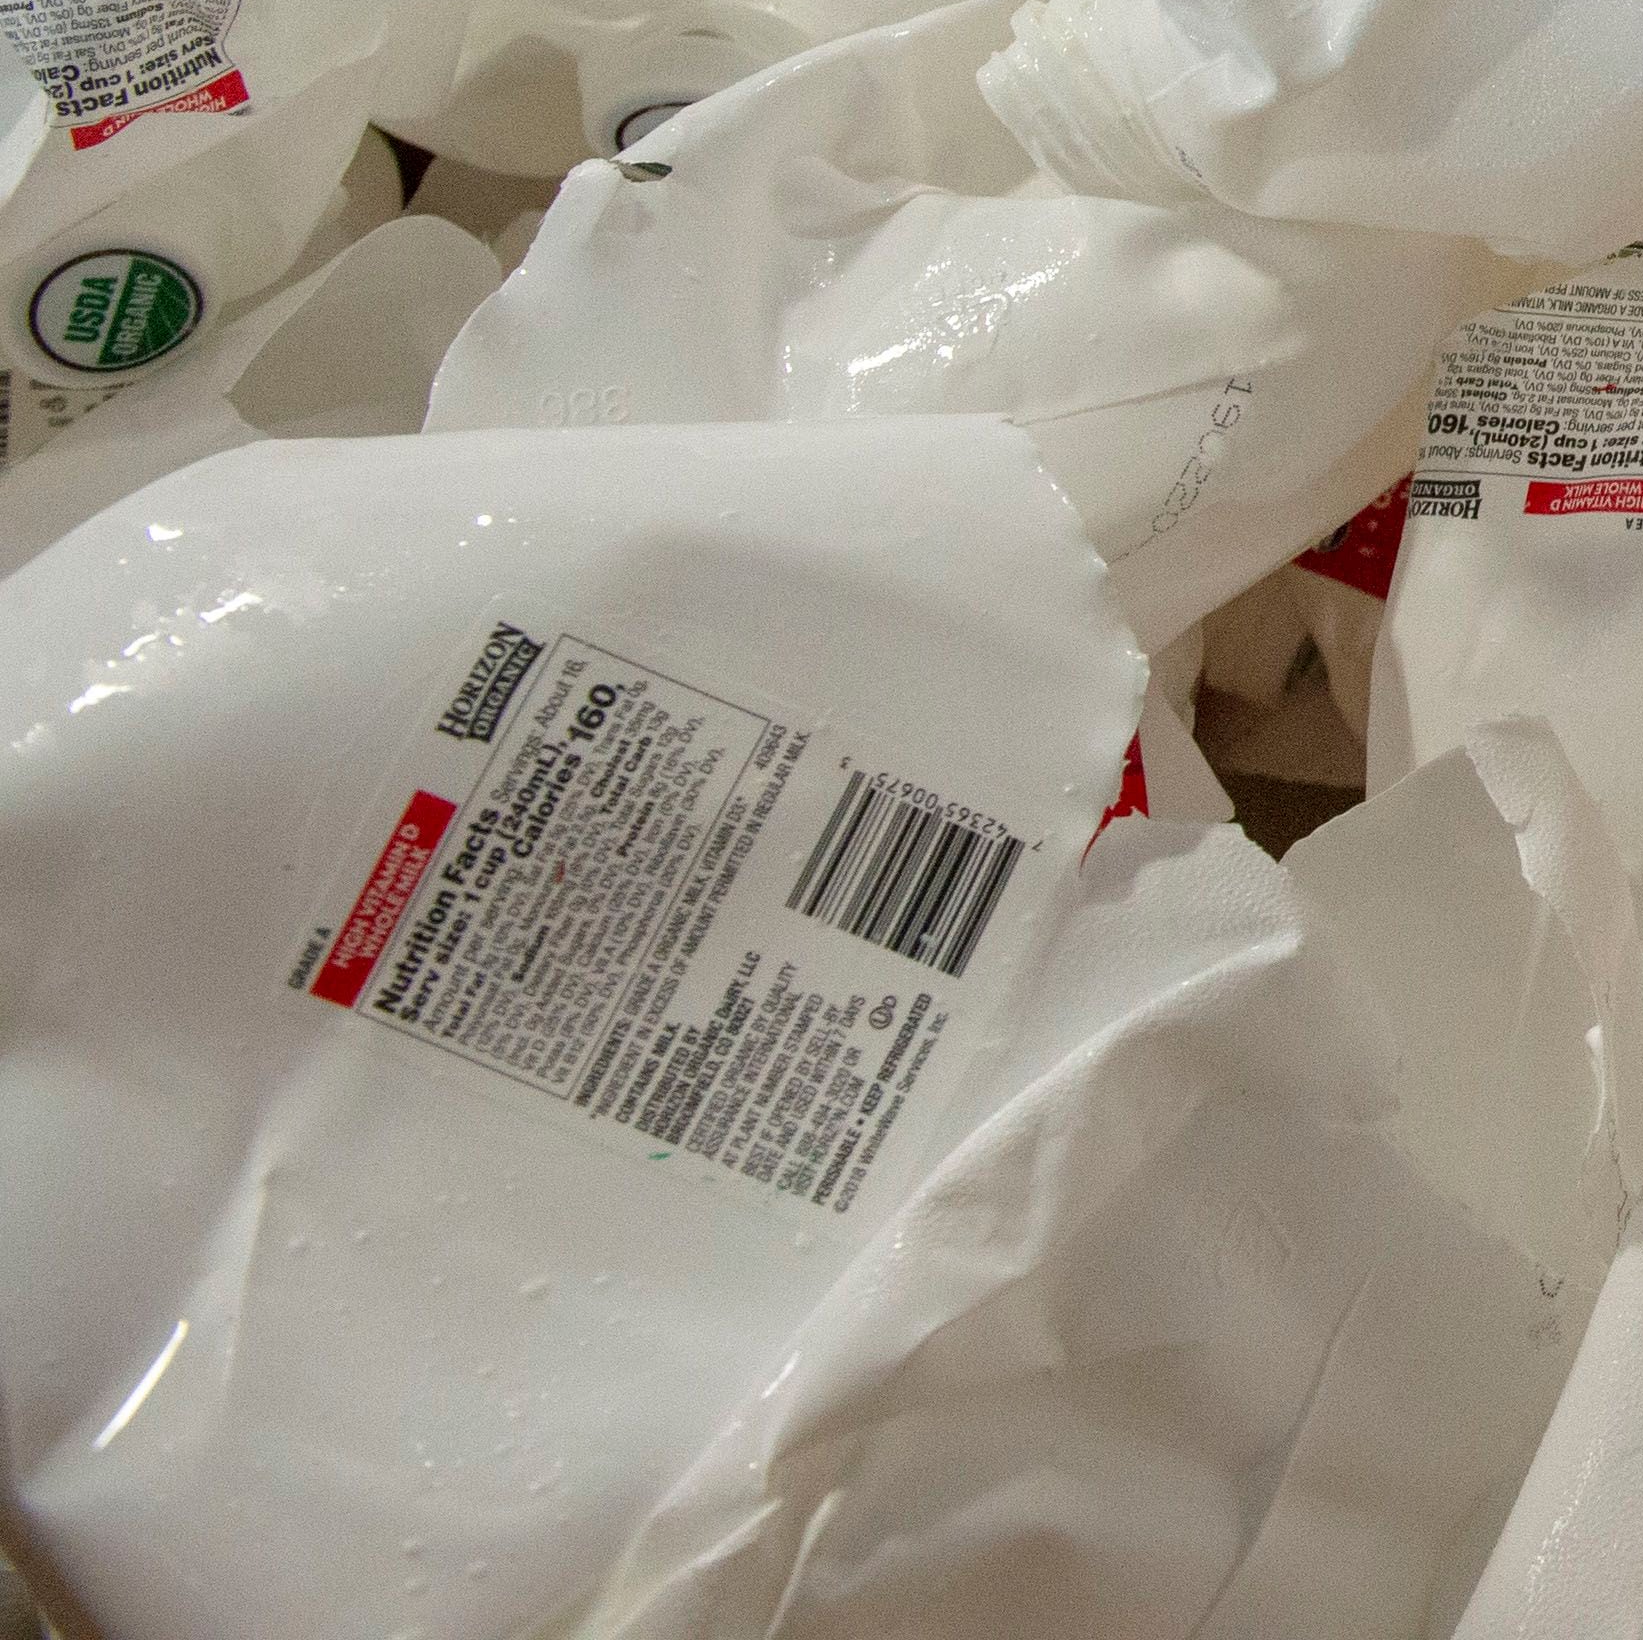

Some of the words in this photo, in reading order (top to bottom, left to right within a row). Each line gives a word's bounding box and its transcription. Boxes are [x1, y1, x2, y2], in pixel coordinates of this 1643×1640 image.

[133, 45, 221, 97] Nutrition
[138, 48, 178, 75] size:
[79, 70, 122, 96] cup
[54, 87, 129, 121] Facts
[64, 272, 118, 347] USDA
[111, 266, 163, 362] ORGANIC
[1572, 301, 1618, 315] ORGANIC
[1473, 415, 1562, 435] Calories
[1560, 420, 1615, 433] serving:
[1614, 418, 1637, 431] per
[1465, 428, 1549, 449] (240mL),
[1551, 434, 1590, 450] cup
[1600, 437, 1638, 449] size:
[1425, 445, 1463, 461] About
[1462, 445, 1523, 463] Servings:
[1523, 450, 1588, 471] Facts
[1561, 495, 1614, 509] VITAMIN
[1562, 482, 1595, 496] MILK
[1406, 494, 1484, 520] HORIZO
[1548, 499, 1562, 510] D
[1622, 517, 1637, 528] A
[434, 619, 525, 741] HORIZON
[464, 635, 542, 740] ORGANIC
[753, 721, 788, 771] 409643
[375, 883, 457, 1017] Nutrition
[442, 803, 499, 886] Facts
[532, 676, 573, 730] About
[330, 914, 371, 969] HIGH
[358, 839, 411, 919] VITAMIN
[398, 819, 423, 841] D
[358, 889, 407, 959] WHOLE
[392, 842, 432, 894] MILK
[418, 961, 468, 1034] Amount
[457, 929, 491, 965] per
[509, 749, 583, 862] Calories
[397, 968, 440, 1025] Serv
[426, 906, 473, 967] size:
[466, 842, 510, 896] cup
[286, 937, 325, 990] GRADE
[682, 1018, 723, 1080] ORGANIC
[811, 1125, 861, 1207] PERISHABLE
[858, 1081, 886, 1116] KEEP
[875, 990, 933, 1084] REFRIGERATED
